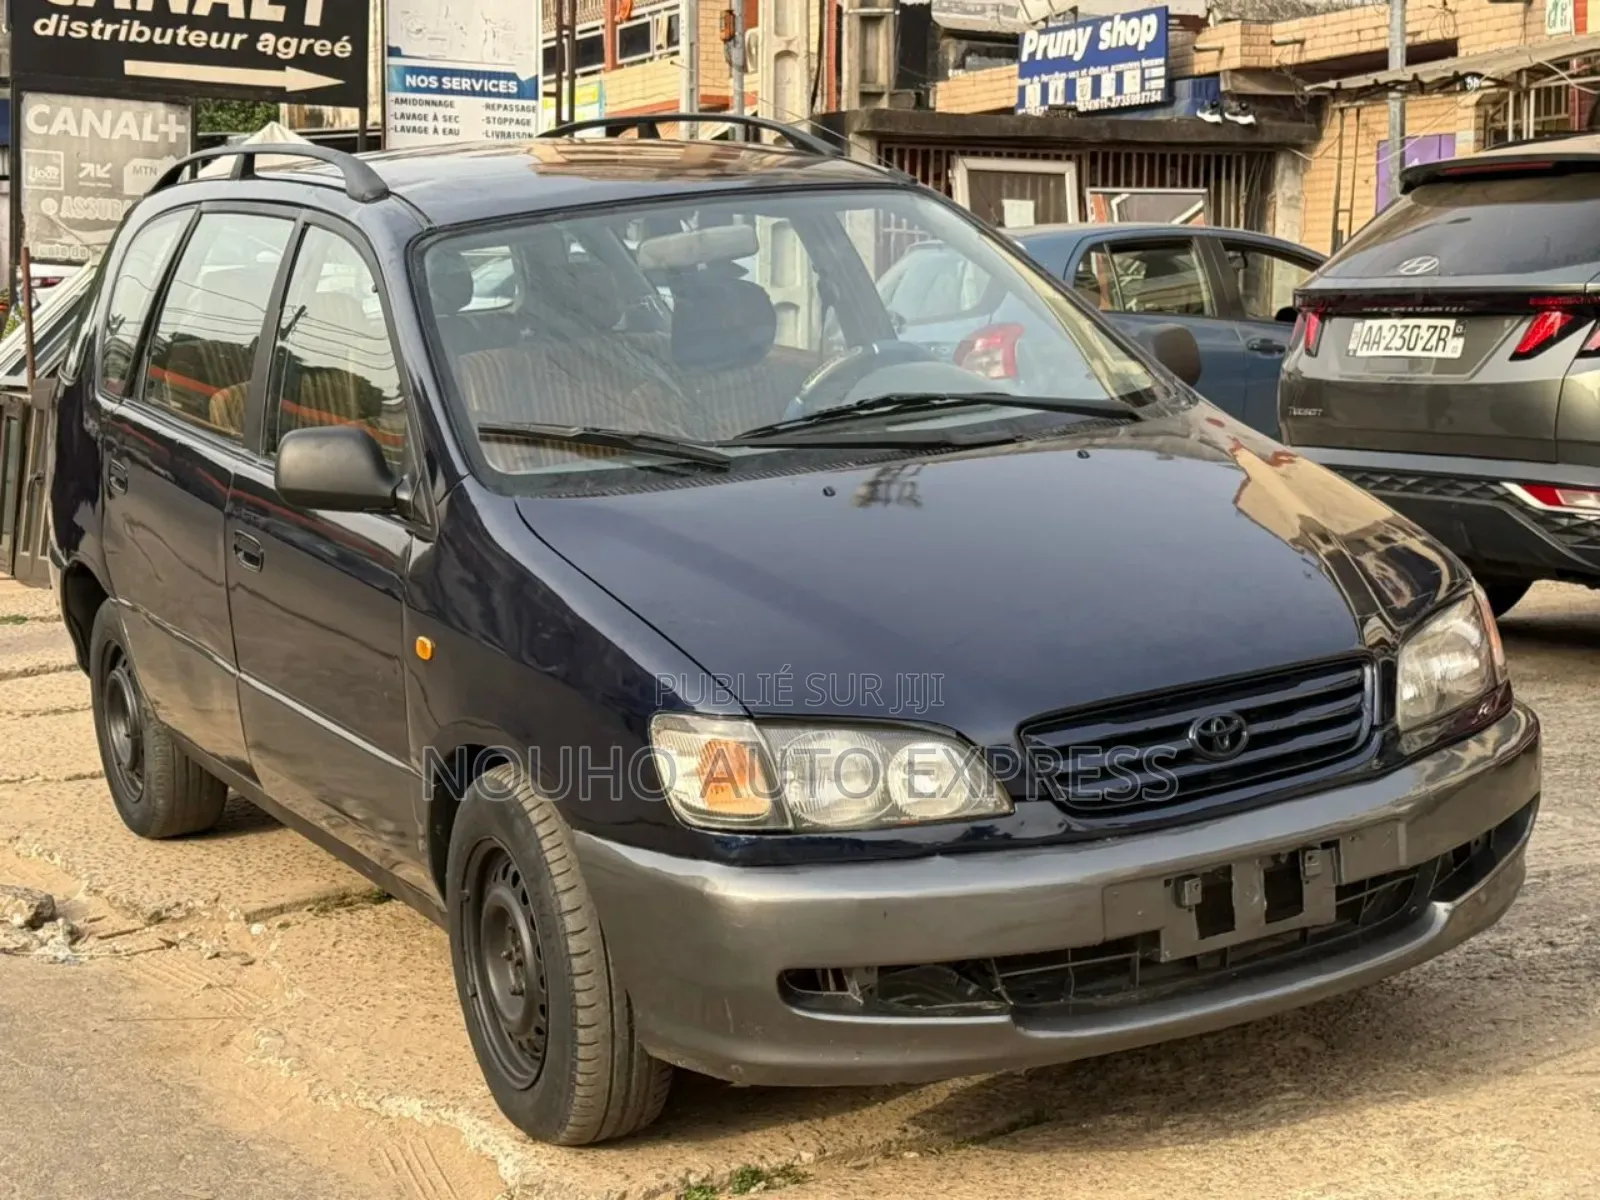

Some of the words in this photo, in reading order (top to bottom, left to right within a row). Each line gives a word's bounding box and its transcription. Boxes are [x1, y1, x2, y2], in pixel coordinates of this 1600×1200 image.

[33, 14, 248, 50] distributeur
[256, 32, 352, 60] agreé
[1021, 26, 1093, 62] Pruny
[1098, 14, 1158, 51] shop
[405, 74, 438, 88] NOS
[441, 77, 518, 93] SERVICES
[26, 104, 186, 143] CANAL+
[442, 115, 460, 123] SEC
[442, 128, 460, 136] EAU
[132, 165, 158, 177] MTN
